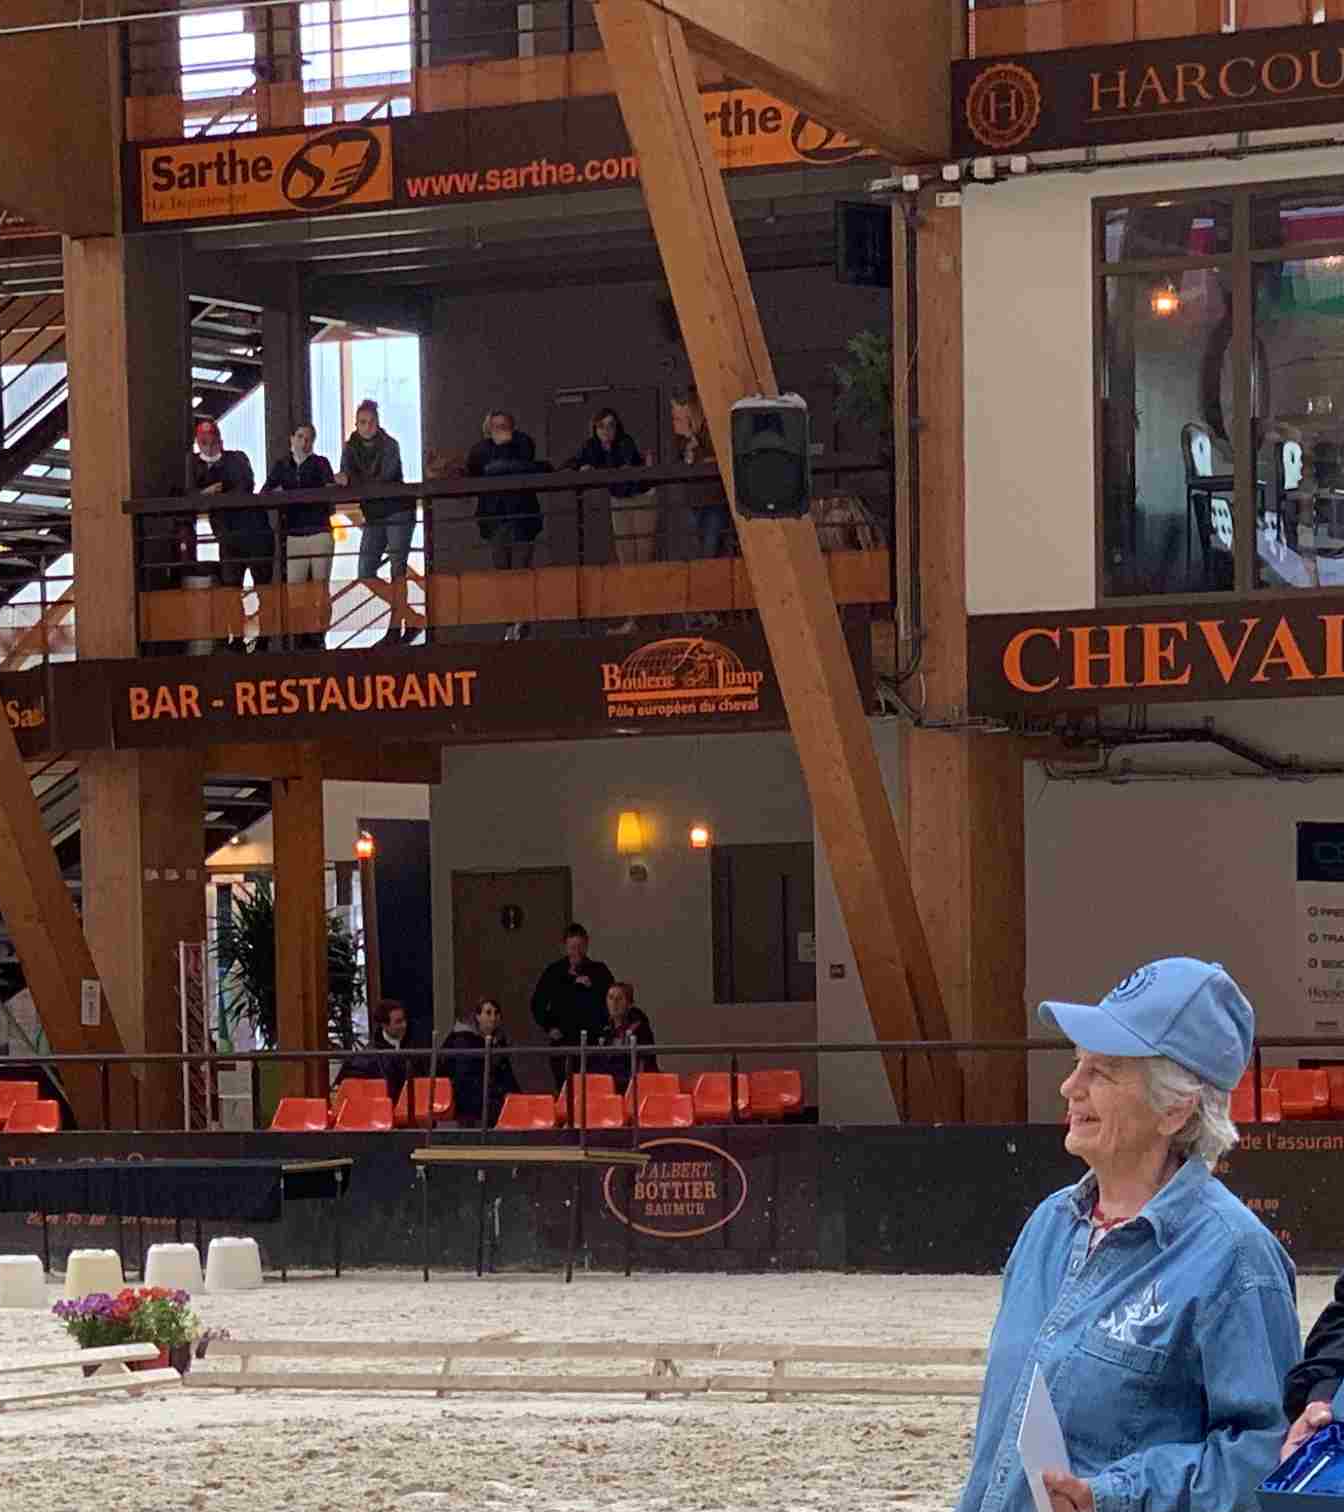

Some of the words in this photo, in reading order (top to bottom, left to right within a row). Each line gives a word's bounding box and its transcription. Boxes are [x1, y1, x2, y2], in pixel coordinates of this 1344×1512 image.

[152, 149, 273, 192] Sarthe
[128, 684, 202, 721] BAR
[233, 670, 478, 717] RESTAURANT
[699, 701, 716, 713] du
[718, 697, 760, 713] cheval
[1240, 1134, 1262, 1150] de
[634, 1180, 717, 1201] BOTTIER
[644, 1201, 705, 1216] SAUMUR
